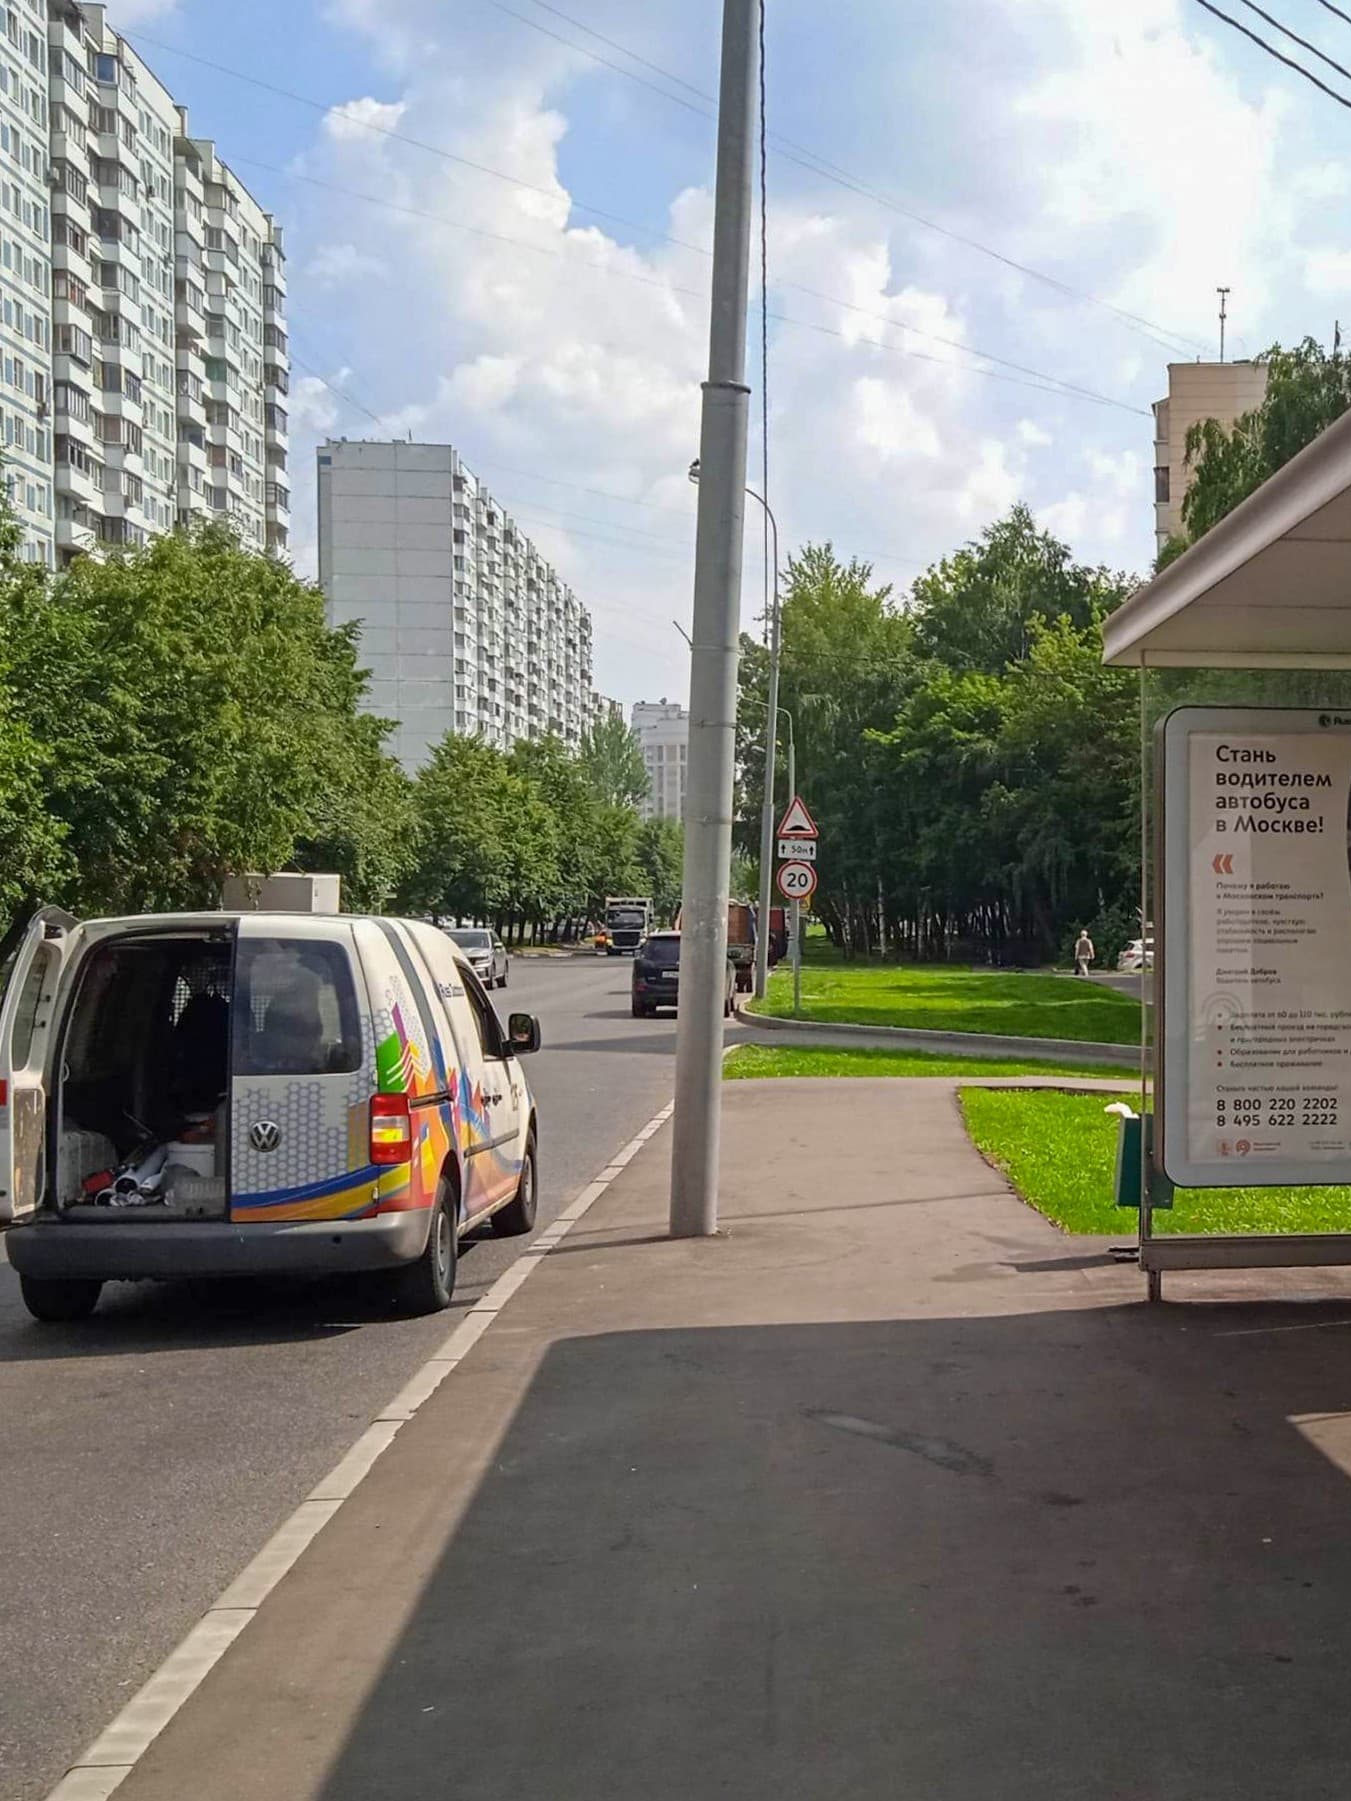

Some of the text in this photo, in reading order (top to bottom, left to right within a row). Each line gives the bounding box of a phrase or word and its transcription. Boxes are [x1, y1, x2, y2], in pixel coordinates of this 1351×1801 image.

[1216, 744, 1277, 762] Стань
[1216, 772, 1332, 788] водителем
[1216, 792, 1310, 814] автобуса
[1216, 815, 1323, 832] в Москве!
[787, 872, 808, 888] 20
[1216, 1098, 1338, 1111] 8 800 220 2202
[1216, 1114, 1337, 1127] 8 495 622 2222
